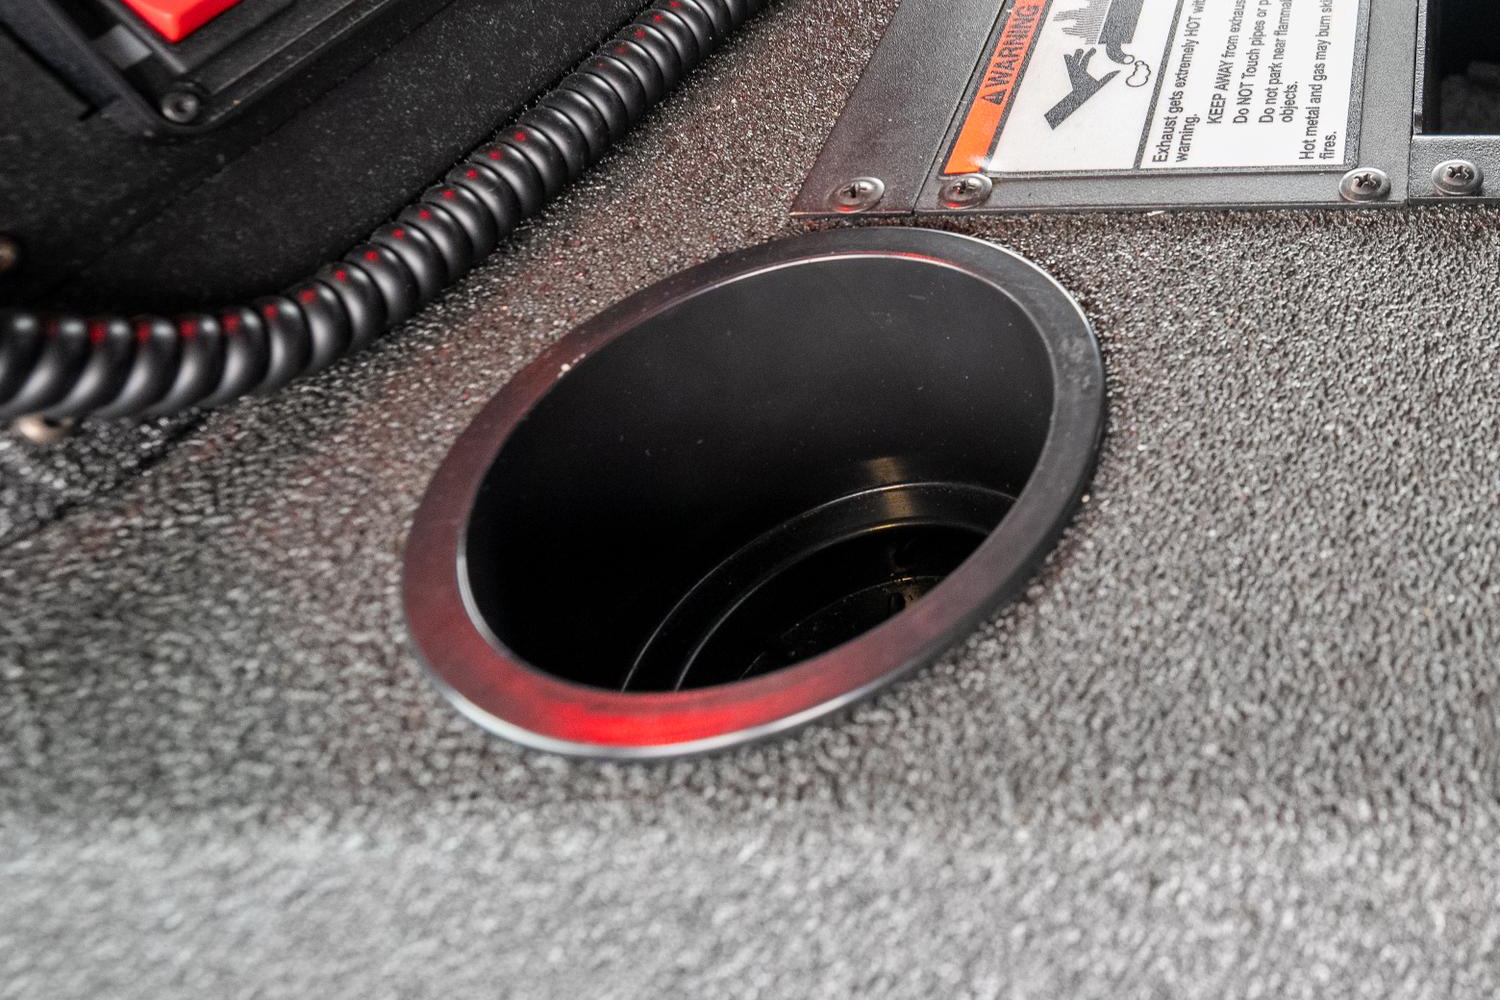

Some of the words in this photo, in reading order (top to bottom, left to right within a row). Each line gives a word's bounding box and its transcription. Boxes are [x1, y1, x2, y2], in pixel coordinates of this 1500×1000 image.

[1256, 6, 1267, 18] or
[1184, 15, 1202, 37] HOT
[1251, 17, 1267, 46] pipes
[1315, 13, 1331, 37] burn
[984, 5, 1040, 89] WARNING
[1221, 34, 1239, 58] from
[1273, 38, 1286, 60] near
[1316, 39, 1332, 61] may
[1174, 37, 1199, 87] extremely
[1241, 43, 1261, 80] Touch
[1268, 59, 1283, 85] park
[1313, 63, 1327, 81] gas
[1218, 60, 1235, 91] AWAY
[1168, 90, 1183, 114] gets
[1236, 82, 1254, 105] NOT
[1265, 87, 1278, 105] not
[1279, 81, 1298, 123] objects.
[1309, 84, 1323, 105] and
[1206, 93, 1227, 124] KEEP
[1232, 108, 1250, 124] Do
[1258, 107, 1275, 123] Do
[1304, 105, 1319, 138] metal
[1152, 116, 1177, 163] Exhaust
[1176, 113, 1200, 163] warning.
[1298, 138, 1317, 160] Hot
[1318, 130, 1337, 160] fires.
